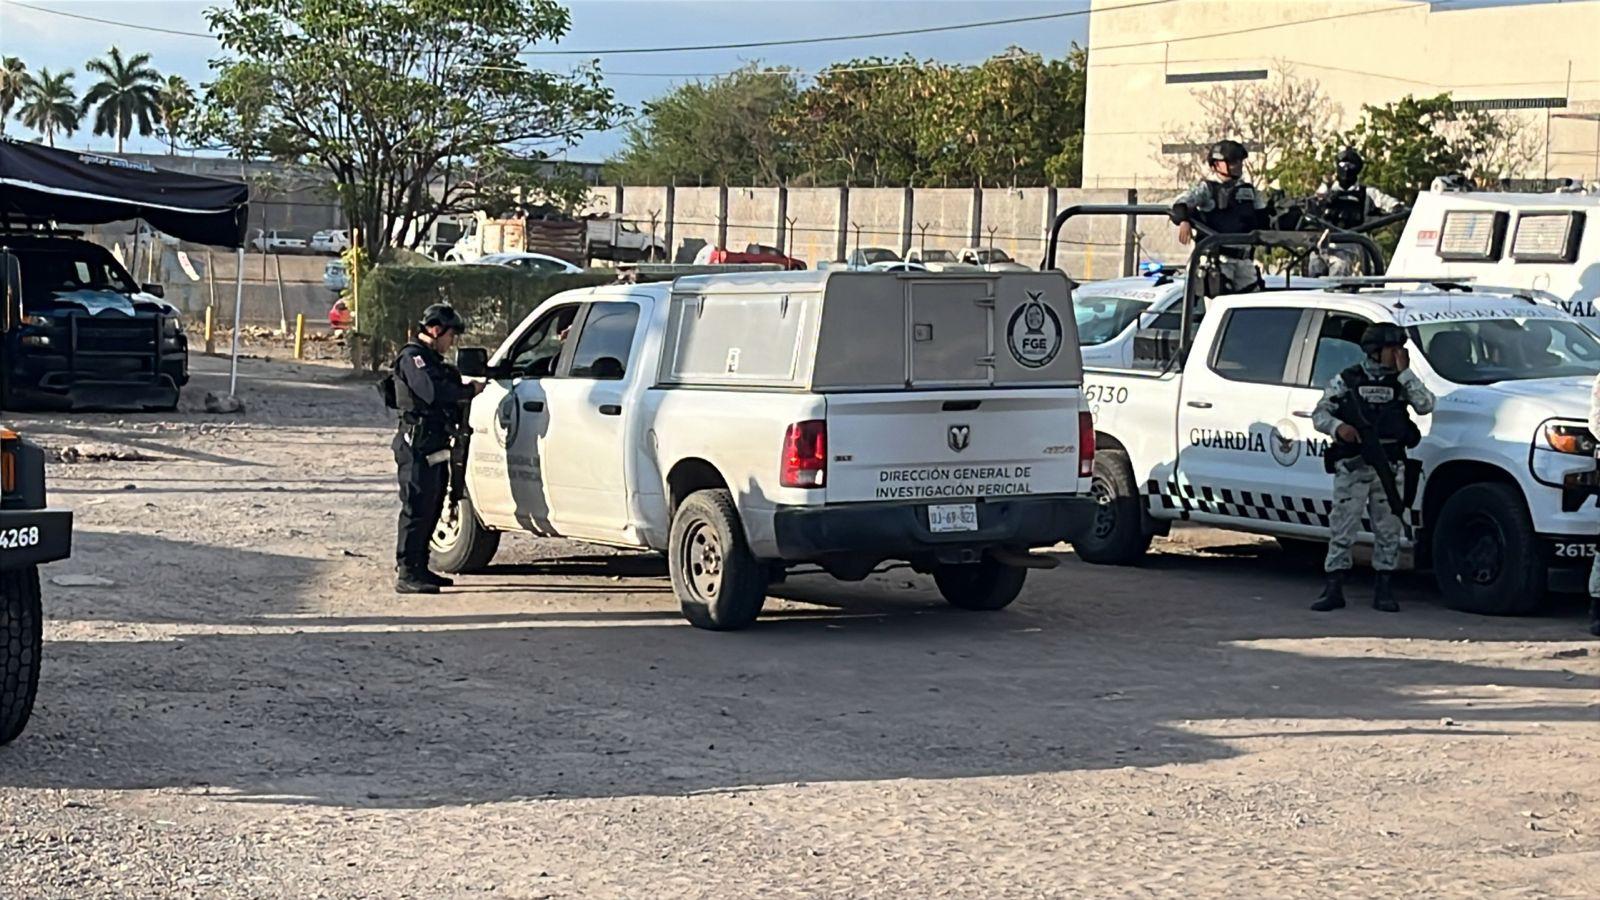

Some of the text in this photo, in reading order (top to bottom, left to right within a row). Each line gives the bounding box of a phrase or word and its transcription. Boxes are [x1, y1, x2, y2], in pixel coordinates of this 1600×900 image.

[1022, 338, 1047, 349] FGE
[1085, 384, 1129, 404] 6130
[1190, 427, 1266, 452] GUARDIA
[879, 466, 1032, 482] DIRECCIÓN GENERAL DE
[875, 483, 1033, 498] INVESTIGACIÓN PERICIAL
[0, 526, 39, 549] 4268
